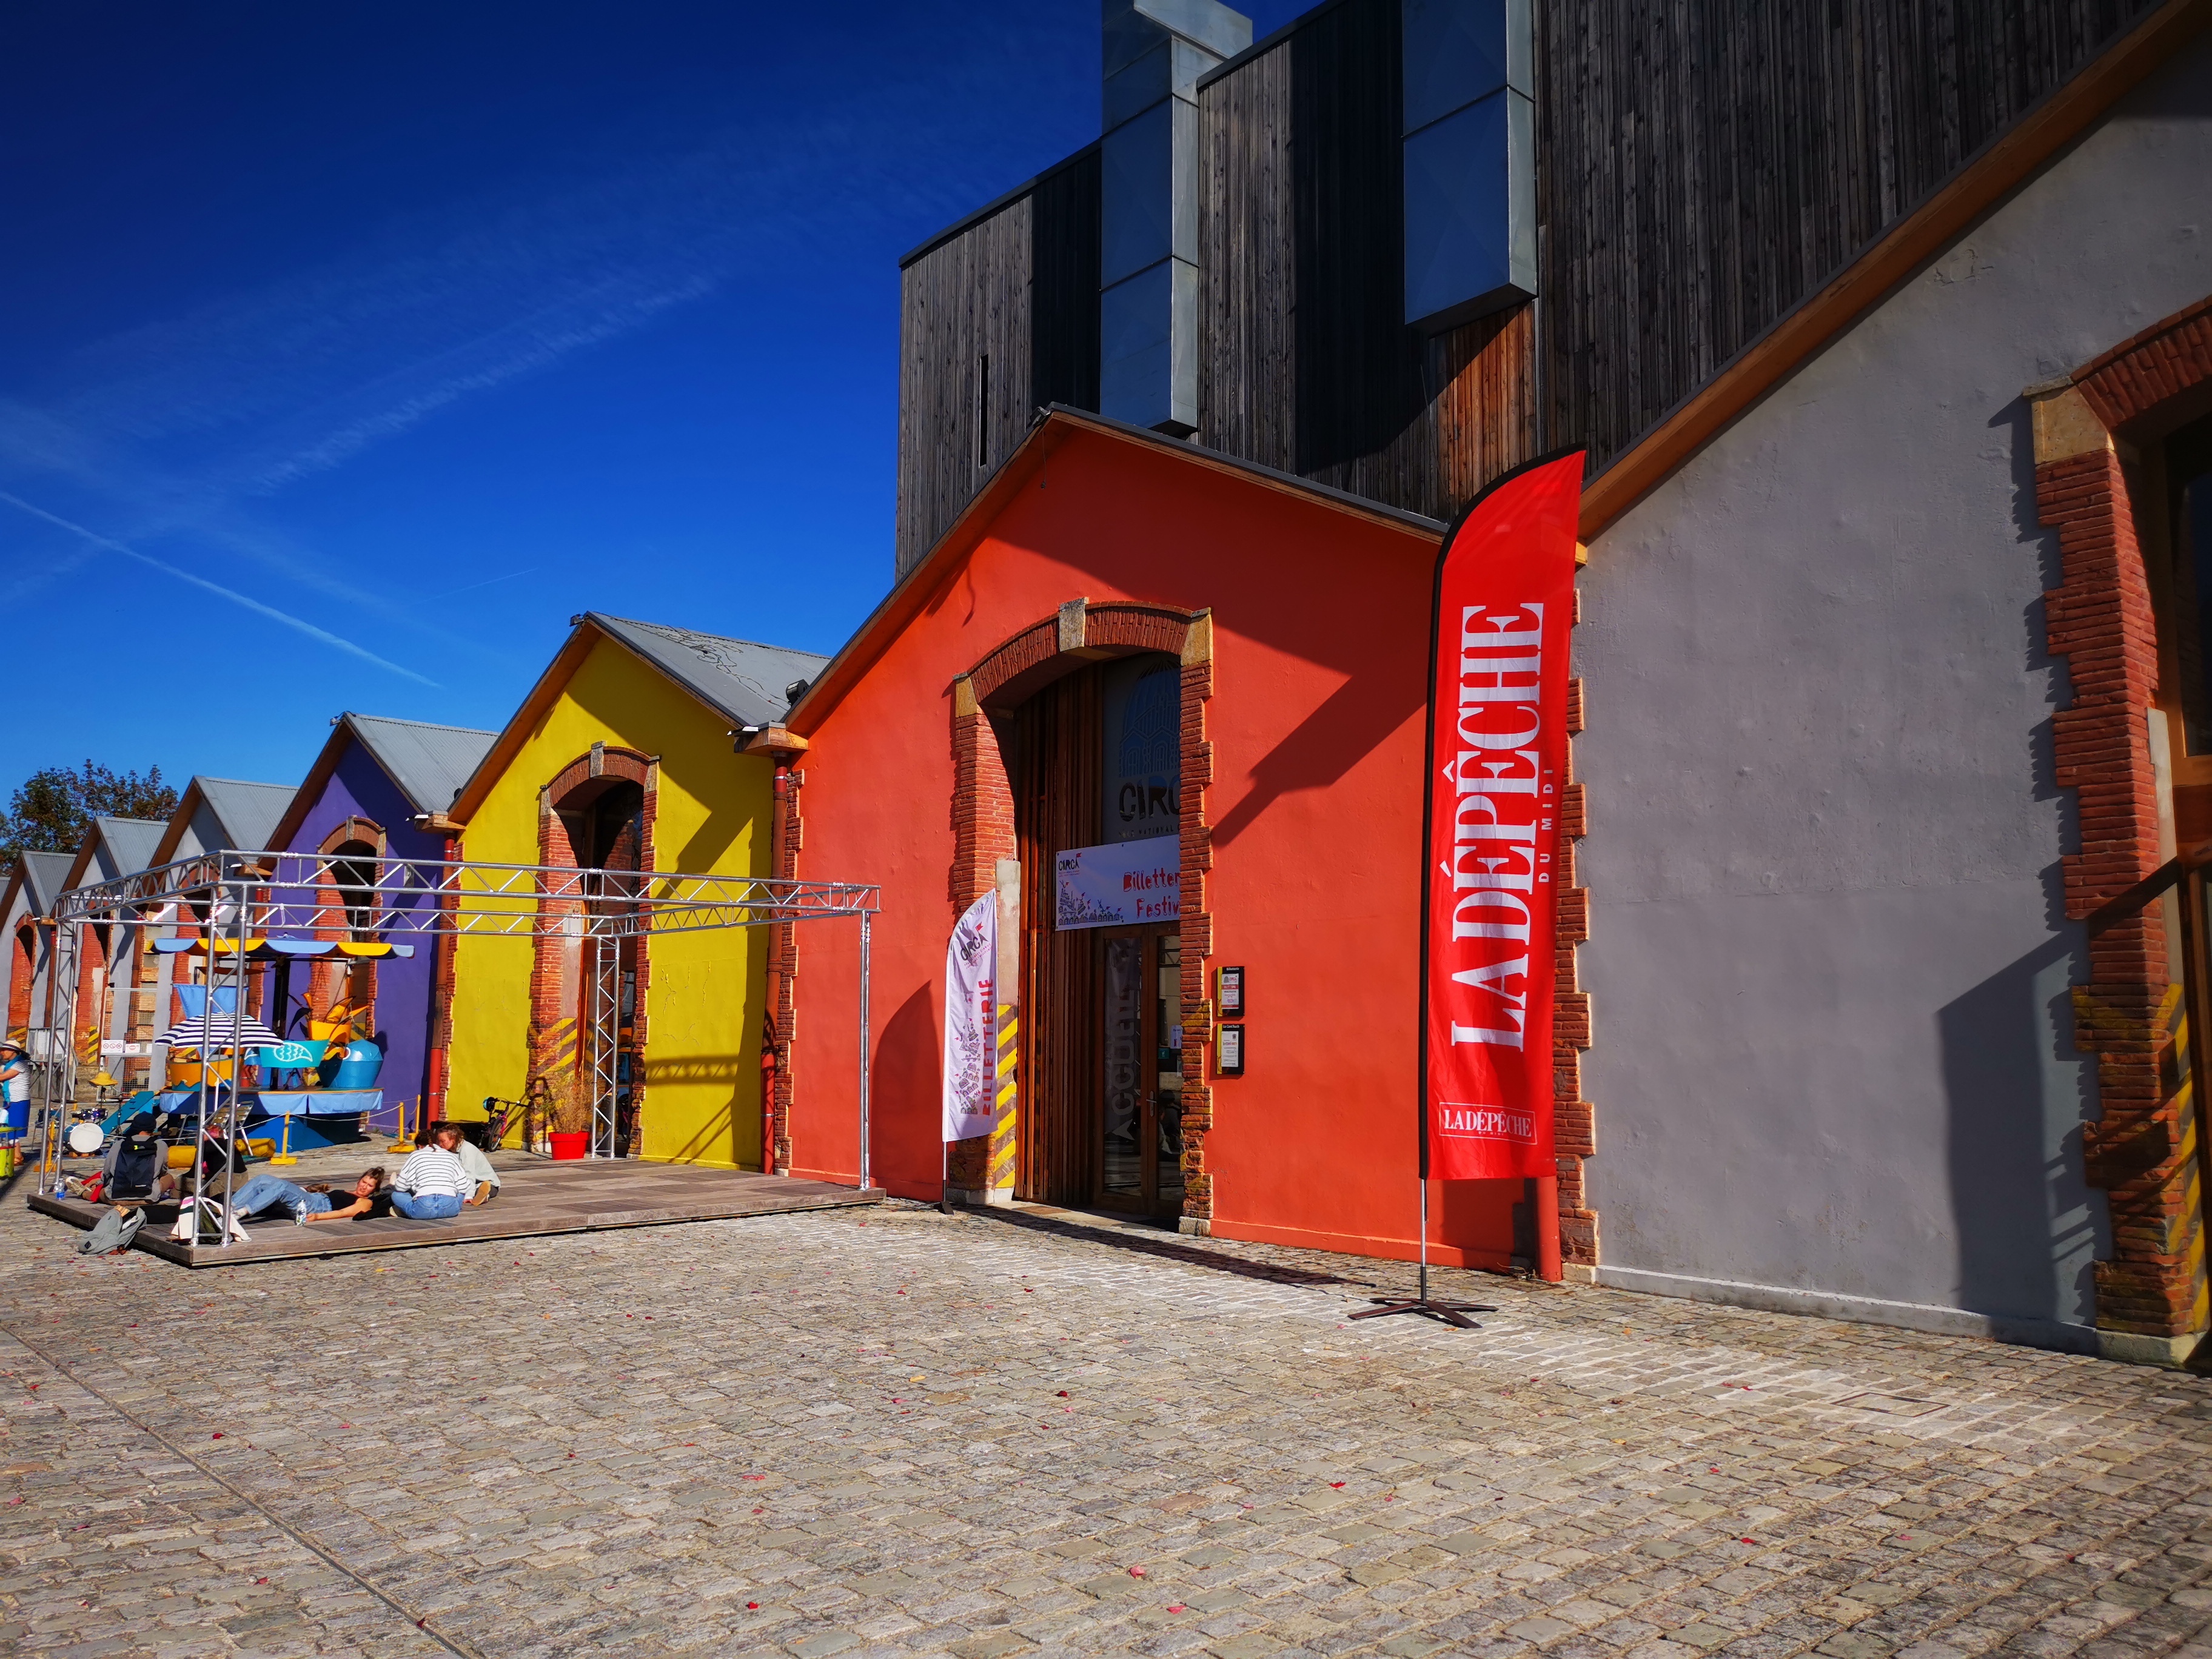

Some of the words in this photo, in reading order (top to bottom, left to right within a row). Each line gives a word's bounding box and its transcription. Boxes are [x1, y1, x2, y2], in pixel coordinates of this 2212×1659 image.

[1541, 769, 1553, 830] MIDI
[1059, 858, 1079, 871] CIRCA
[1539, 853, 1551, 883] DU
[960, 931, 988, 960] CIRCA
[979, 979, 993, 1116] BILLETTERIE
